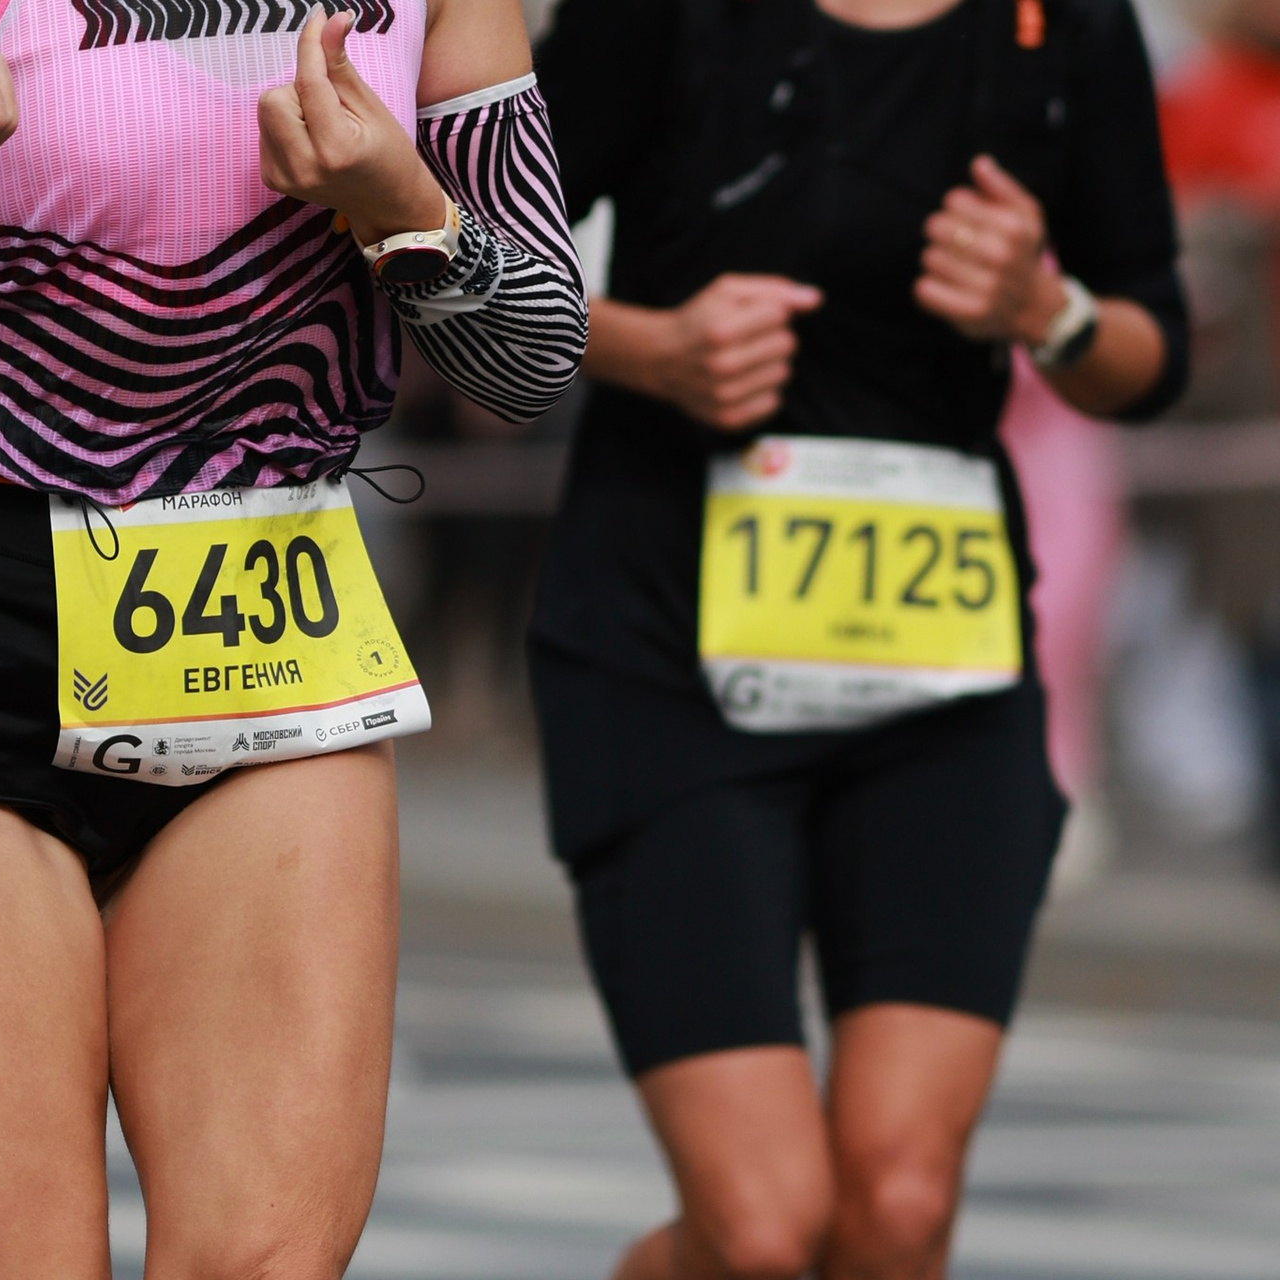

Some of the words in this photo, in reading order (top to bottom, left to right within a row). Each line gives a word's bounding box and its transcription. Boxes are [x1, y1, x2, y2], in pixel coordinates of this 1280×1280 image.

[162, 492, 243, 511] МАРАФОН
[726, 515, 997, 612] 17125
[113, 535, 339, 654] 6430
[370, 651, 383, 665] 1
[184, 659, 303, 694] ЕВГЕНИЯ
[722, 666, 764, 714] G
[252, 725, 303, 741] МОСКОВСКИЙ
[329, 720, 360, 736] СБЕР
[365, 714, 392, 727] Прайм
[92, 734, 143, 774] G
[252, 740, 277, 751] СПОРТ
